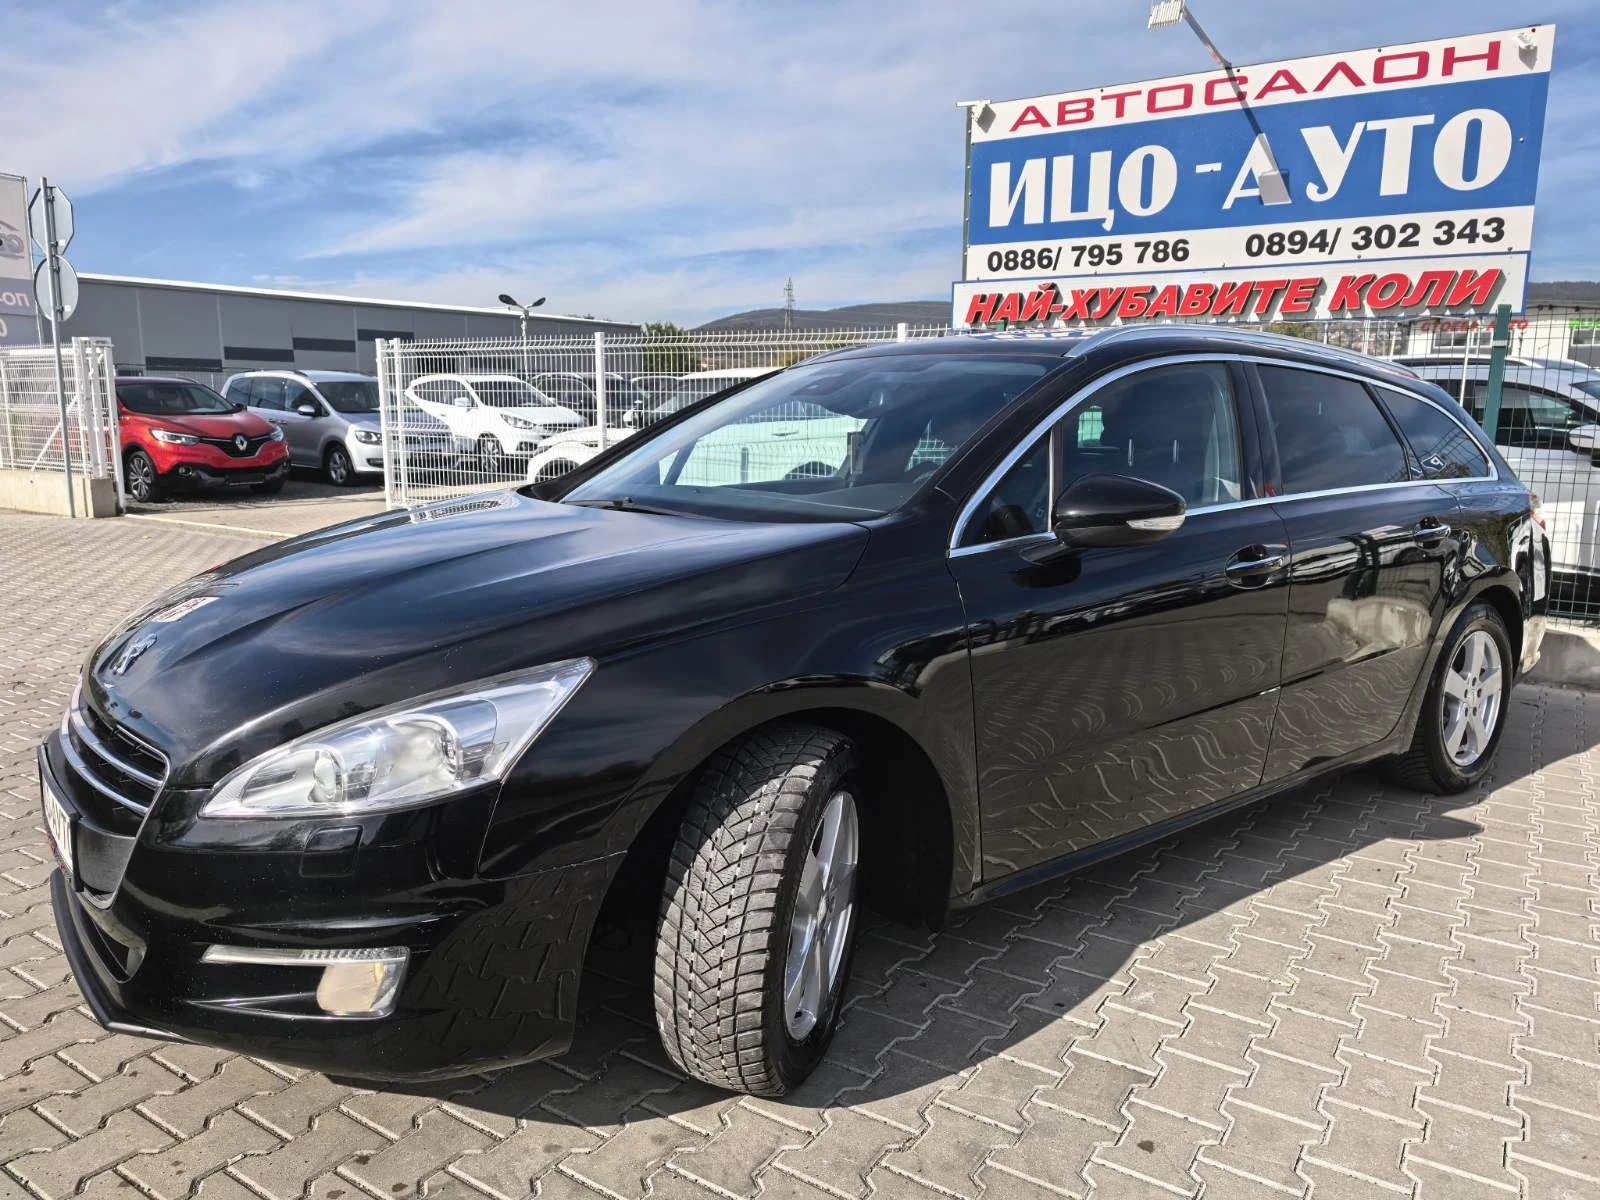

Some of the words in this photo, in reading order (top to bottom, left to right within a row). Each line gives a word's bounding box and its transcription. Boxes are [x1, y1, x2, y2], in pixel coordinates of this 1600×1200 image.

[1008, 39, 1502, 133] АВТОСАЛОН
[986, 246, 1063, 273] 0886/
[1071, 242, 1123, 268] 795
[1134, 238, 1190, 264] 786
[1245, 227, 1342, 257] 0894/
[1351, 222, 1421, 250] 302
[1432, 216, 1506, 246] 343
[964, 276, 1324, 324] НАЙ-ХУБАВИТЕ
[1328, 268, 1503, 312] КОЛИ
